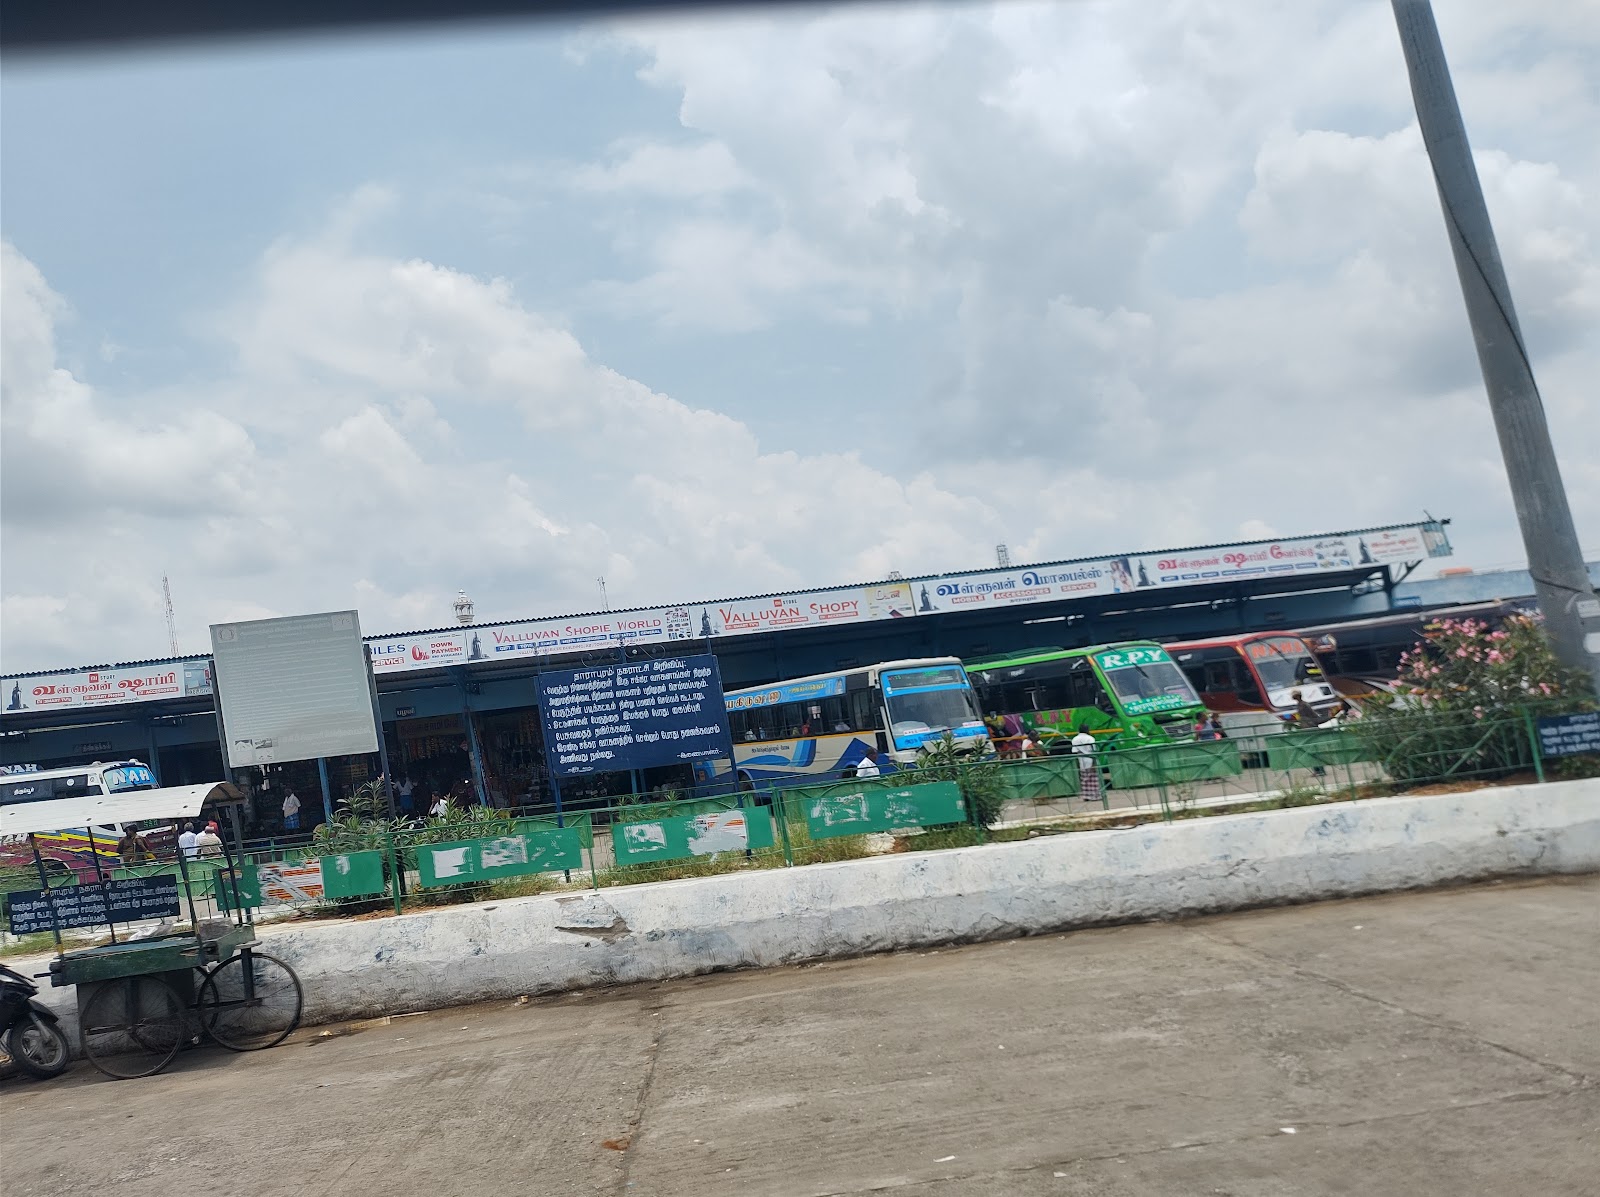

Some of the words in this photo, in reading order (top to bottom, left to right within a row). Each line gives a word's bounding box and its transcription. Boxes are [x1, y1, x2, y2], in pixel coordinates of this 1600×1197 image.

[936, 577, 1016, 597] வள்ளுவன்
[953, 596, 985, 604] MOBILE
[994, 588, 1050, 599] ACCESSORIES
[1062, 583, 1096, 592] SERVICE
[719, 604, 799, 624] VALLUVAN
[809, 600, 858, 614] SHOPY
[493, 628, 559, 644] VALLUVAN
[565, 624, 611, 637] SHOPIE
[617, 618, 662, 631] WORLD
[1103, 649, 1164, 668] R.P.Y
[574, 667, 613, 682] தாராபுரம்
[617, 664, 650, 676] நகராட்சி
[653, 659, 687, 672] அறிவிப்பு:
[32, 681, 113, 696] வள்ளுவன்
[118, 672, 177, 692] ஷாப்பி
[112, 769, 150, 786] NAH
[40, 886, 74, 898] தராபுரம்
[79, 882, 111, 893] நகராசி
